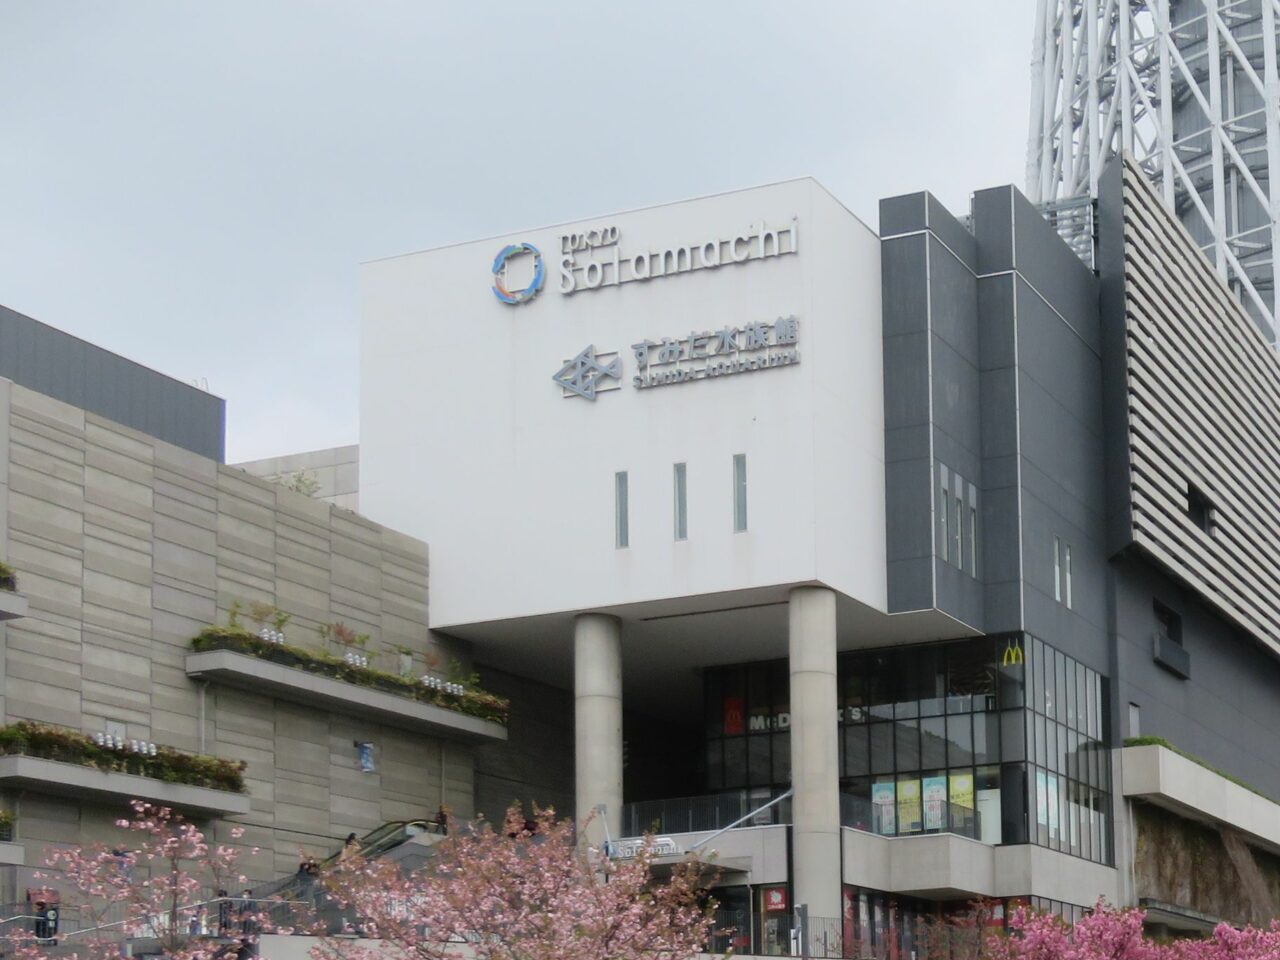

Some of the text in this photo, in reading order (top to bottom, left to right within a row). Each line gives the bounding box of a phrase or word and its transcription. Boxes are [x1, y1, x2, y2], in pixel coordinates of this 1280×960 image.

[558, 225, 620, 252] TOKYO
[560, 216, 799, 295] Solamachi
[631, 315, 800, 370] すみだ水族館
[632, 351, 801, 389] SUMIDA AQUARIUM
